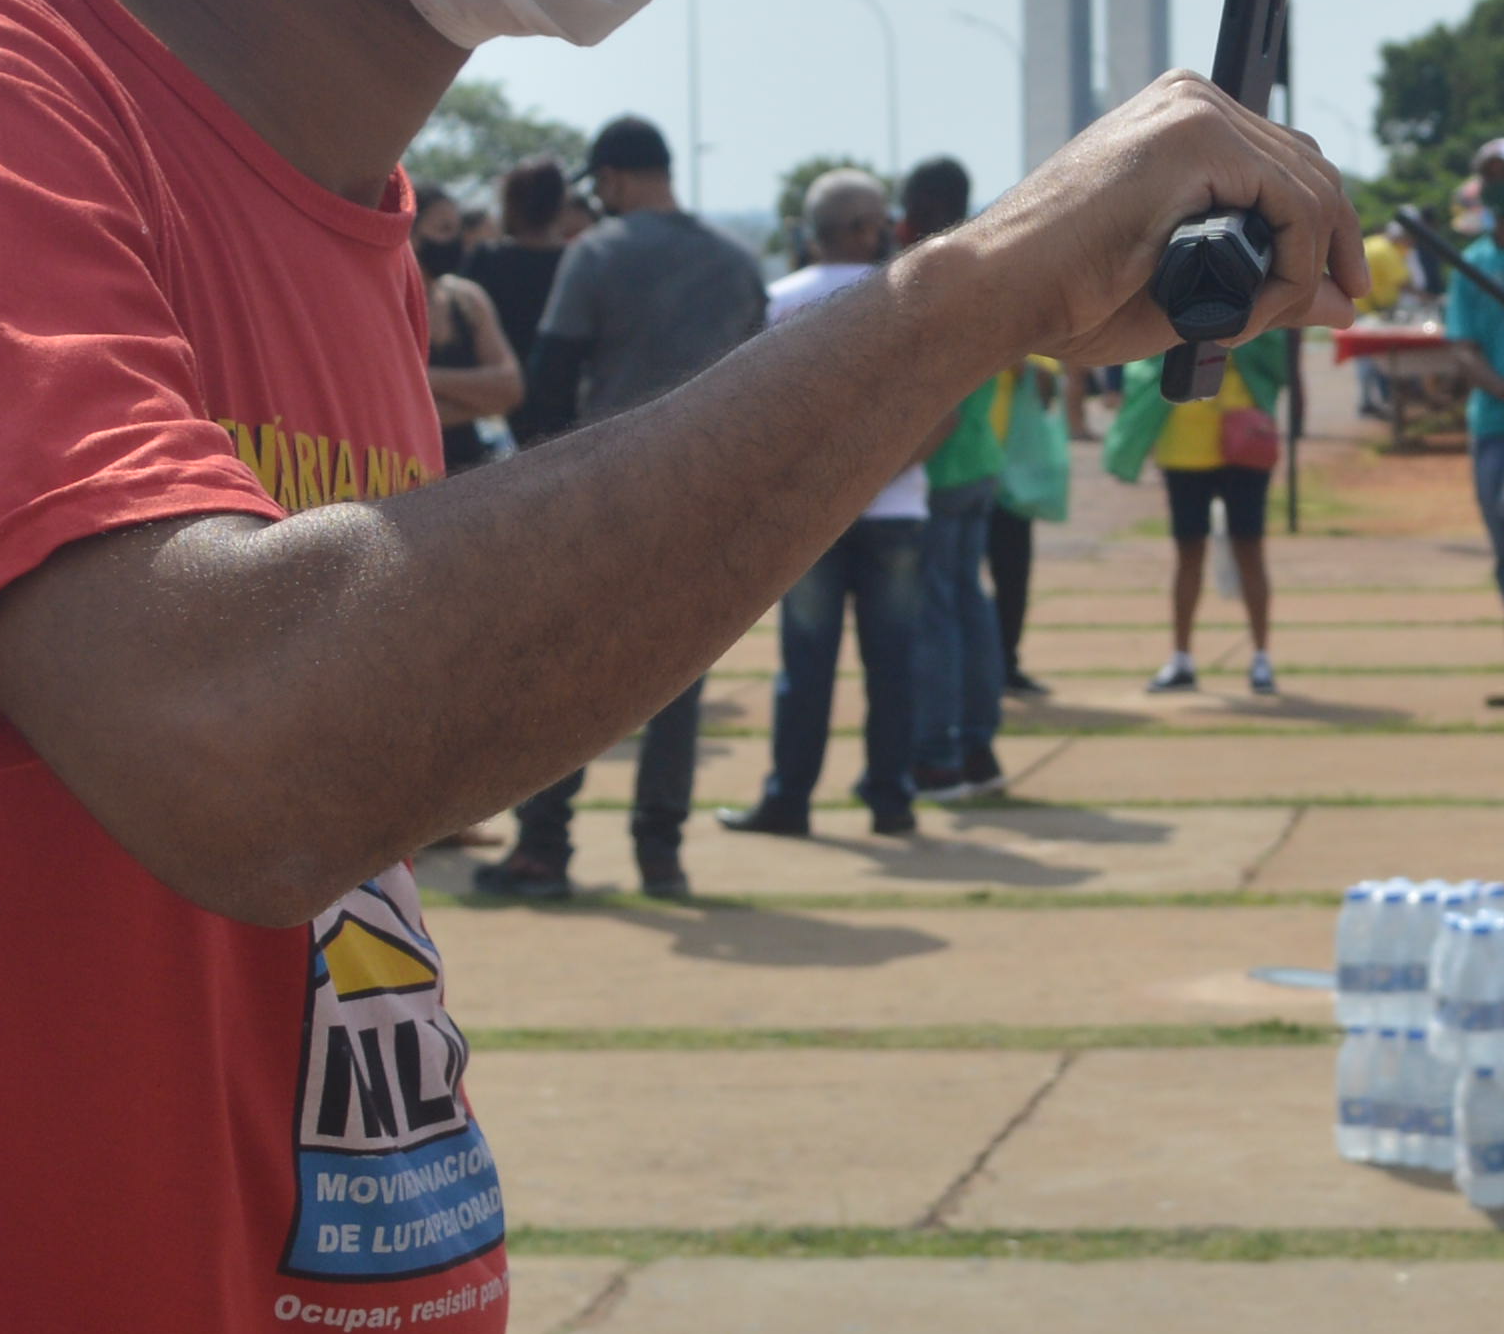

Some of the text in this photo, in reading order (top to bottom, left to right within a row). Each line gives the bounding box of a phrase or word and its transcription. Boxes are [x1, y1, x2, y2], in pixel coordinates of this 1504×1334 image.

[317, 1223, 361, 1254] DE
[274, 1294, 402, 1333] Ocupar,
[411, 1283, 477, 1324] resistir
